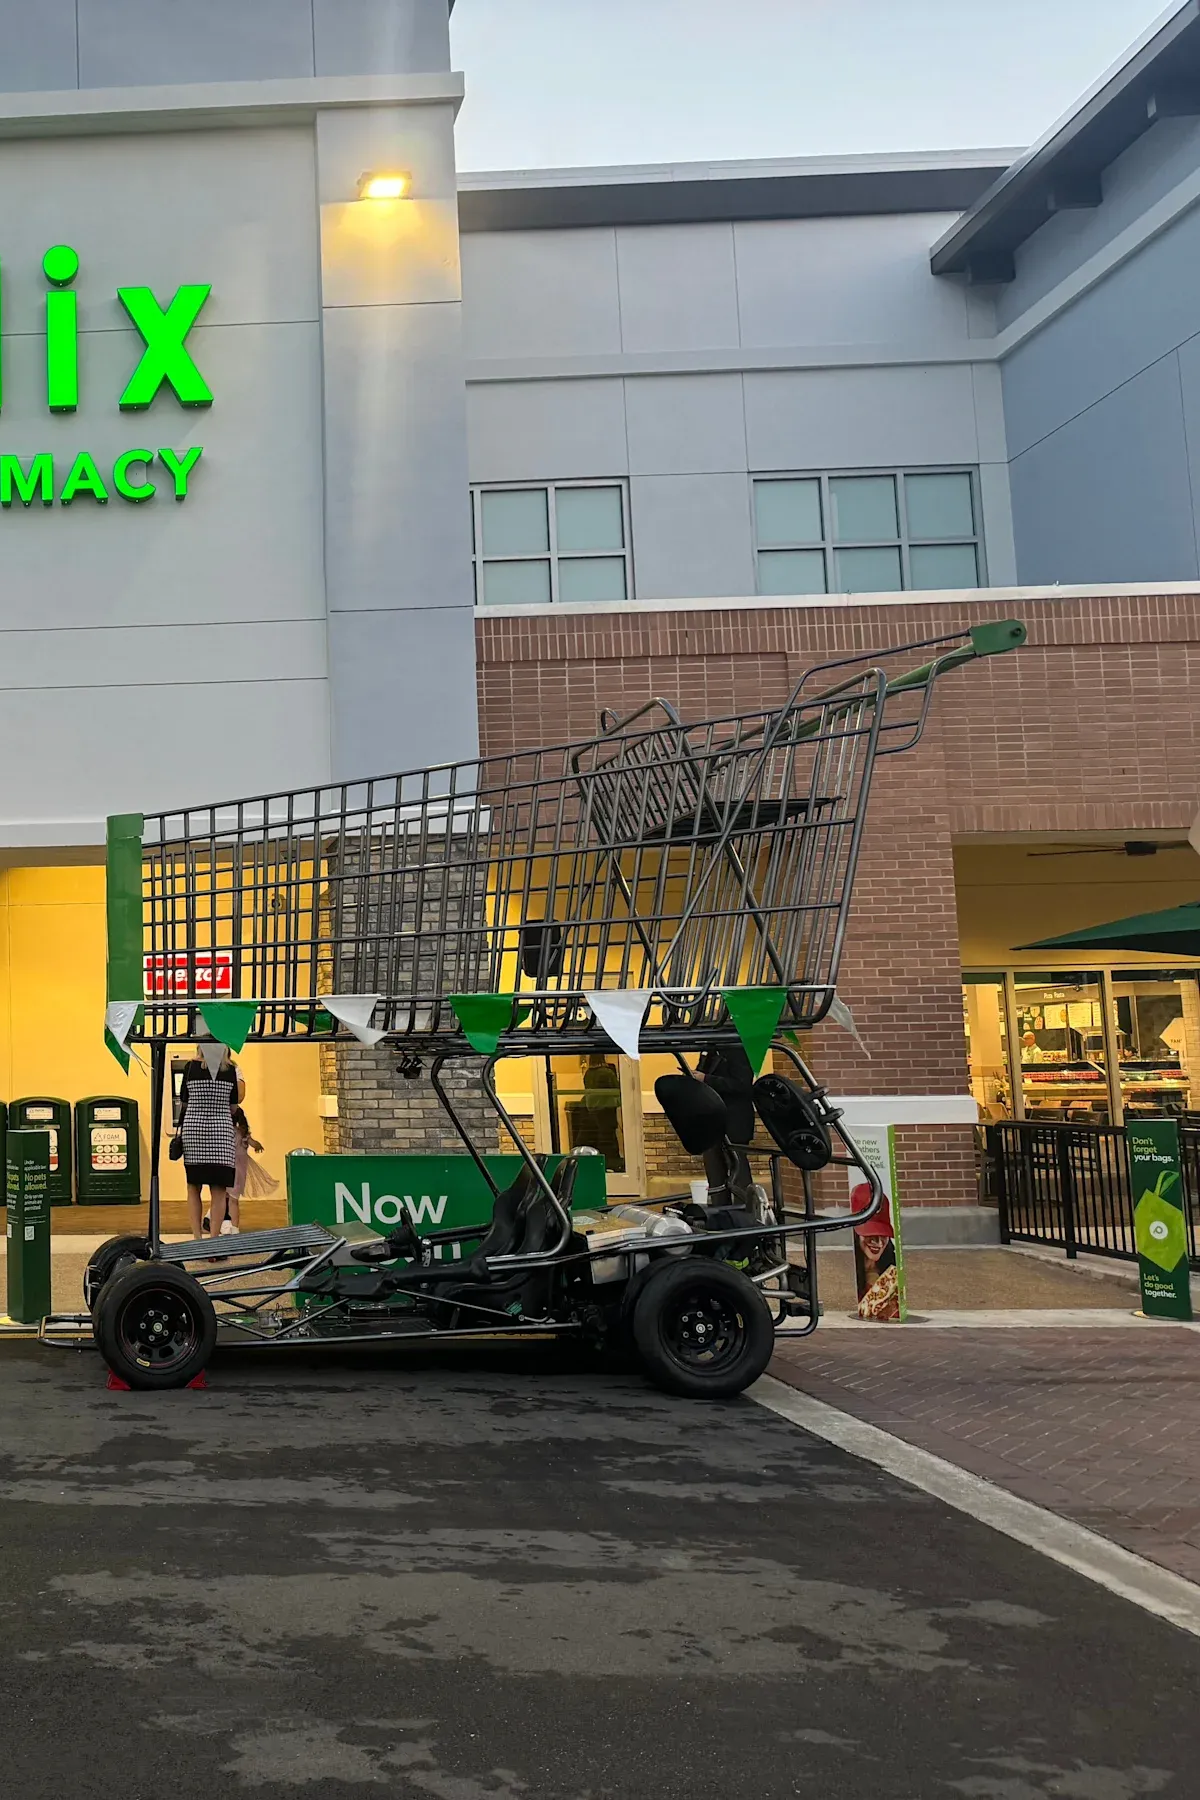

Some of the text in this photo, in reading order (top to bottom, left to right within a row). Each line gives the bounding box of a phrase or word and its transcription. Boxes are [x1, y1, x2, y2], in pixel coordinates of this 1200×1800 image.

[1132, 1136, 1154, 1145] Don't
[1133, 1145, 1157, 1155] forget
[1134, 1153, 1174, 1164] your bags.
[24, 1172, 47, 1183] No pets
[334, 1182, 448, 1224] Now
[1143, 1273, 1160, 1282] Let's
[1154, 1282, 1174, 1291] good
[1144, 1288, 1177, 1299] together.
